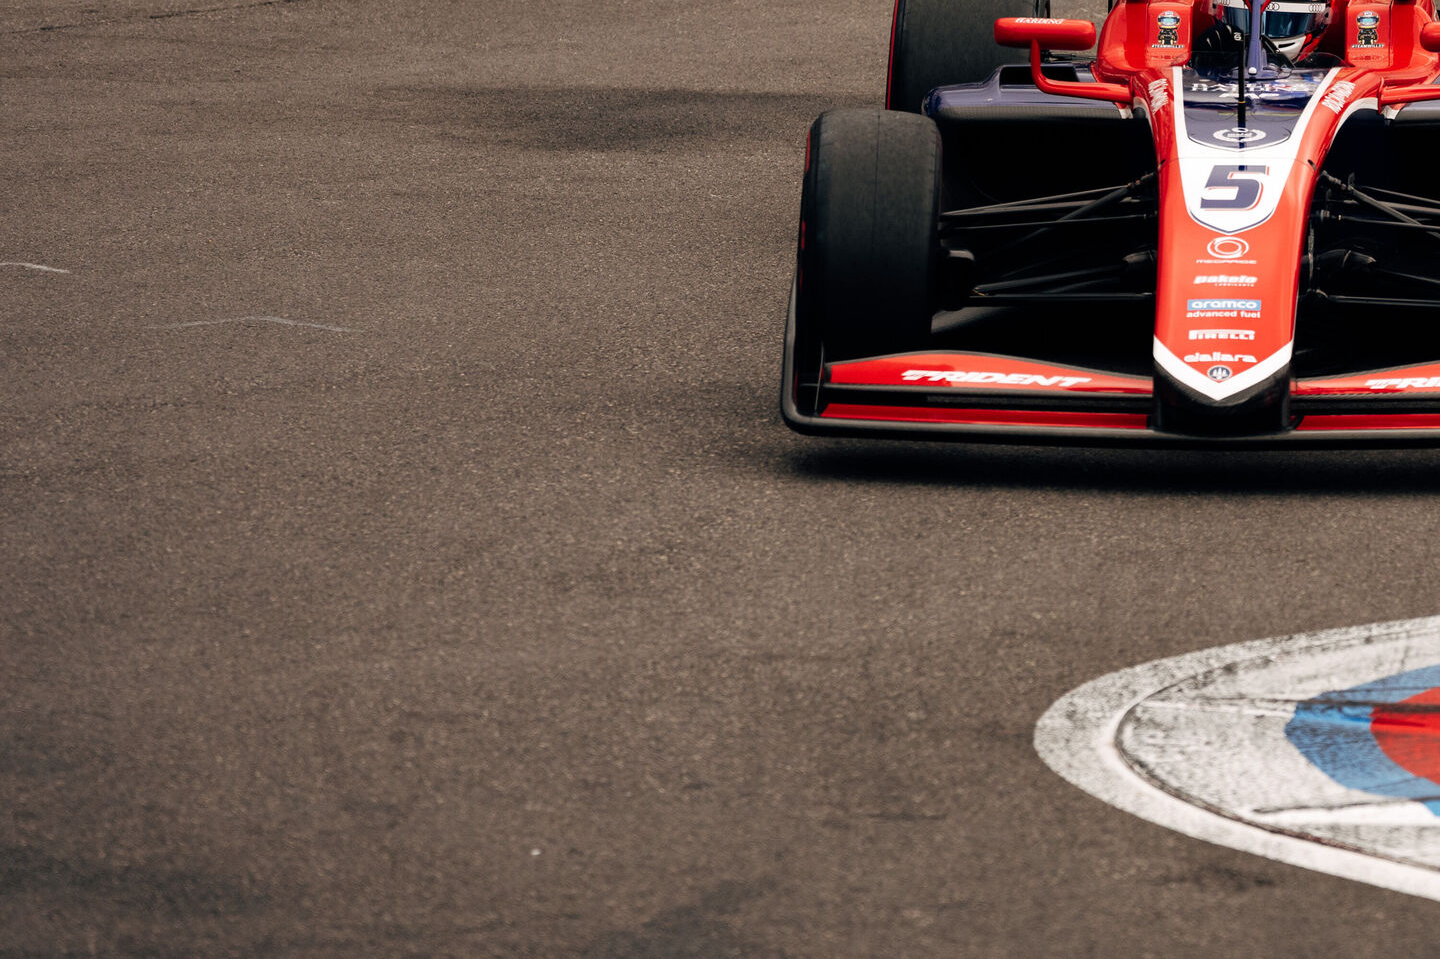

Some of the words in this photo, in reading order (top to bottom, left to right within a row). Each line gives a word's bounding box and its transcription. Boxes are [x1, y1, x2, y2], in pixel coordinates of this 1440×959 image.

[1200, 164, 1270, 212] 5
[1191, 300, 1257, 309] aramco
[1240, 311, 1261, 319] fuel
[1188, 329, 1255, 340] PIRELLI
[901, 369, 1093, 387] TRIDENT
